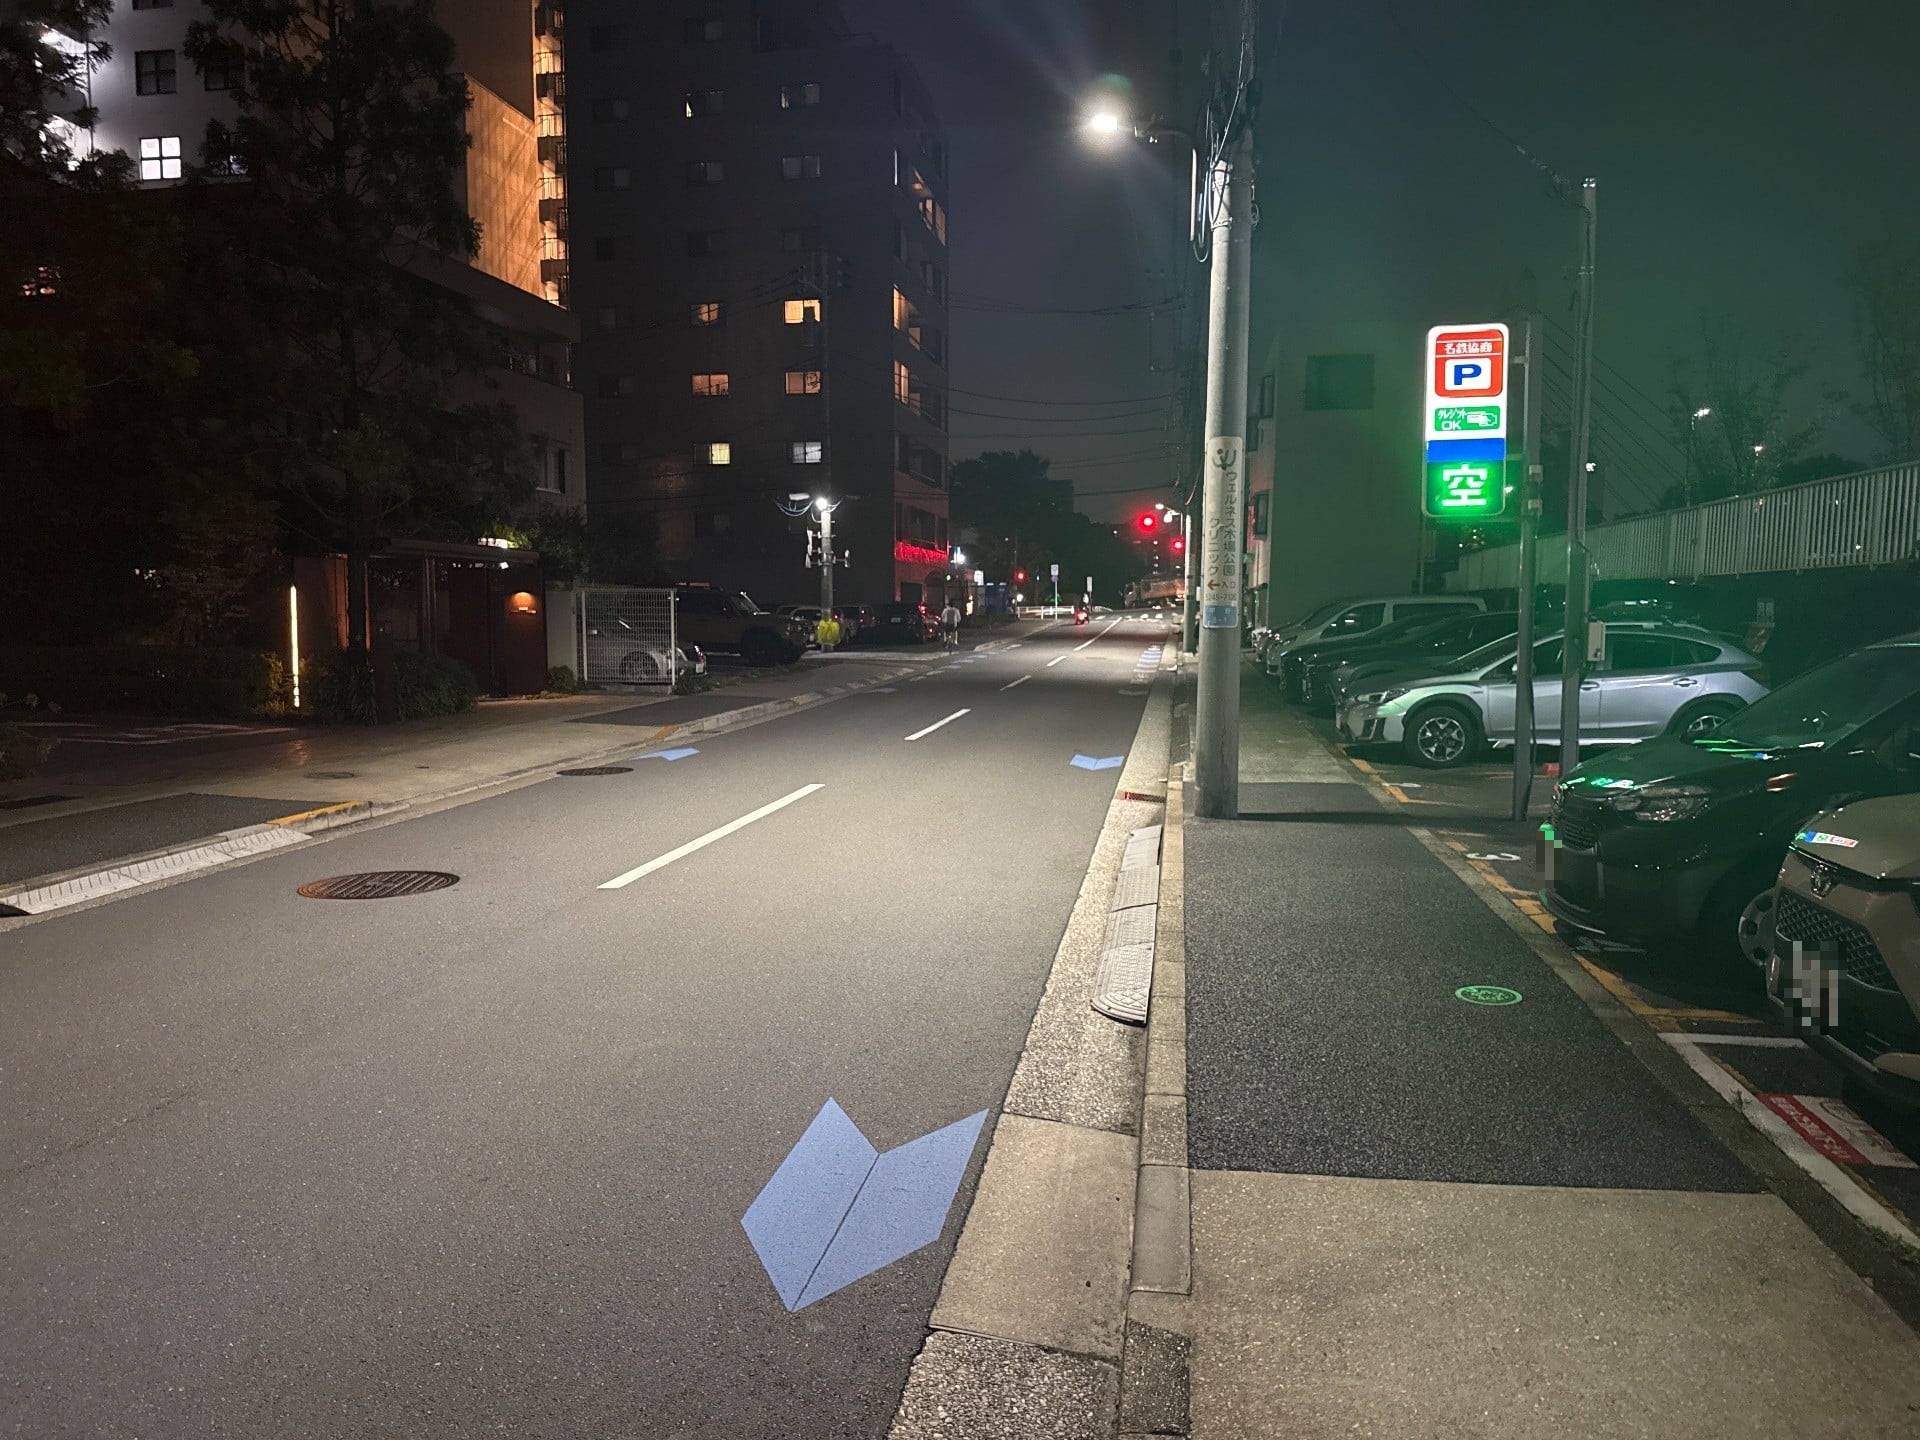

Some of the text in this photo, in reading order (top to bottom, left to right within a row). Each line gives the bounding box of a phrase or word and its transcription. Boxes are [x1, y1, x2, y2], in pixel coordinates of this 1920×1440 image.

[1444, 341, 1493, 355] 名鉄協商
[1453, 363, 1482, 386] P
[1437, 407, 1468, 420] クレジット
[1441, 419, 1462, 431] OK
[1441, 464, 1488, 507] 空
[1207, 517, 1222, 576] クリニック
